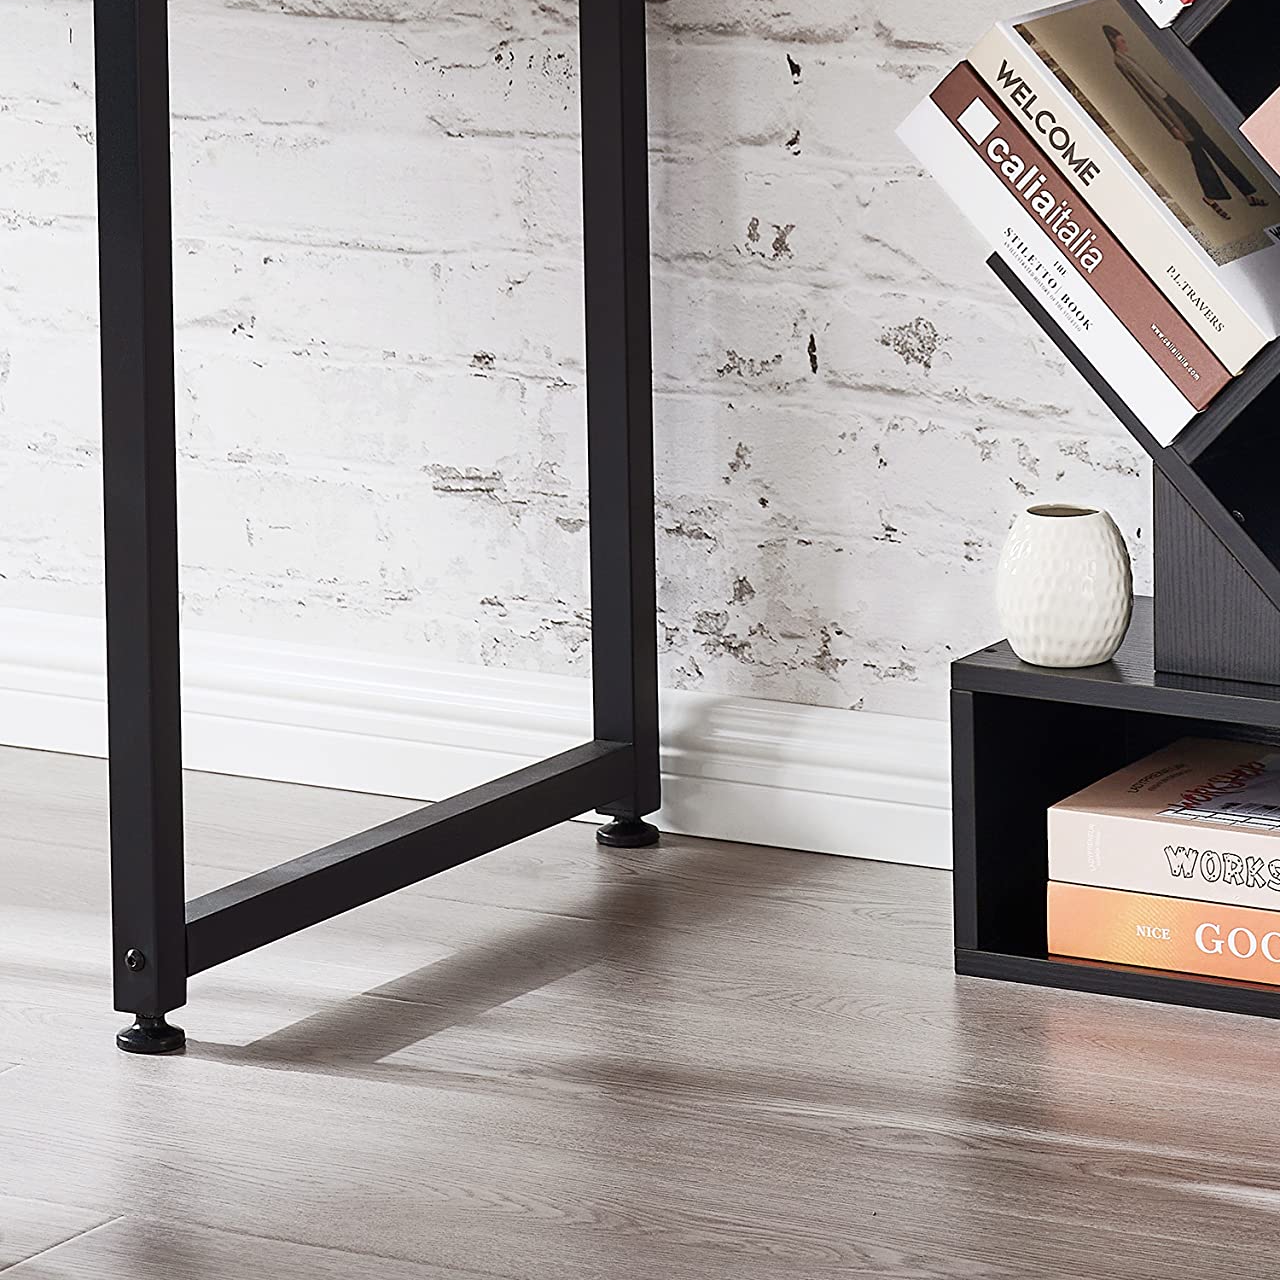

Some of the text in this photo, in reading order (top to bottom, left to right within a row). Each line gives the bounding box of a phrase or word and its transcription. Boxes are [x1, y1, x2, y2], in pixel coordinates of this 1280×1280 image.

[997, 59, 1100, 186] WELCOME
[986, 136, 1104, 274] caliaitalia
[1004, 228, 1094, 331] STILETTO BOOK
[1167, 266, 1224, 332] P.L.TRAVERS
[1148, 322, 1202, 381] www.caliaitalia.com
[1135, 924, 1171, 942] NICE
